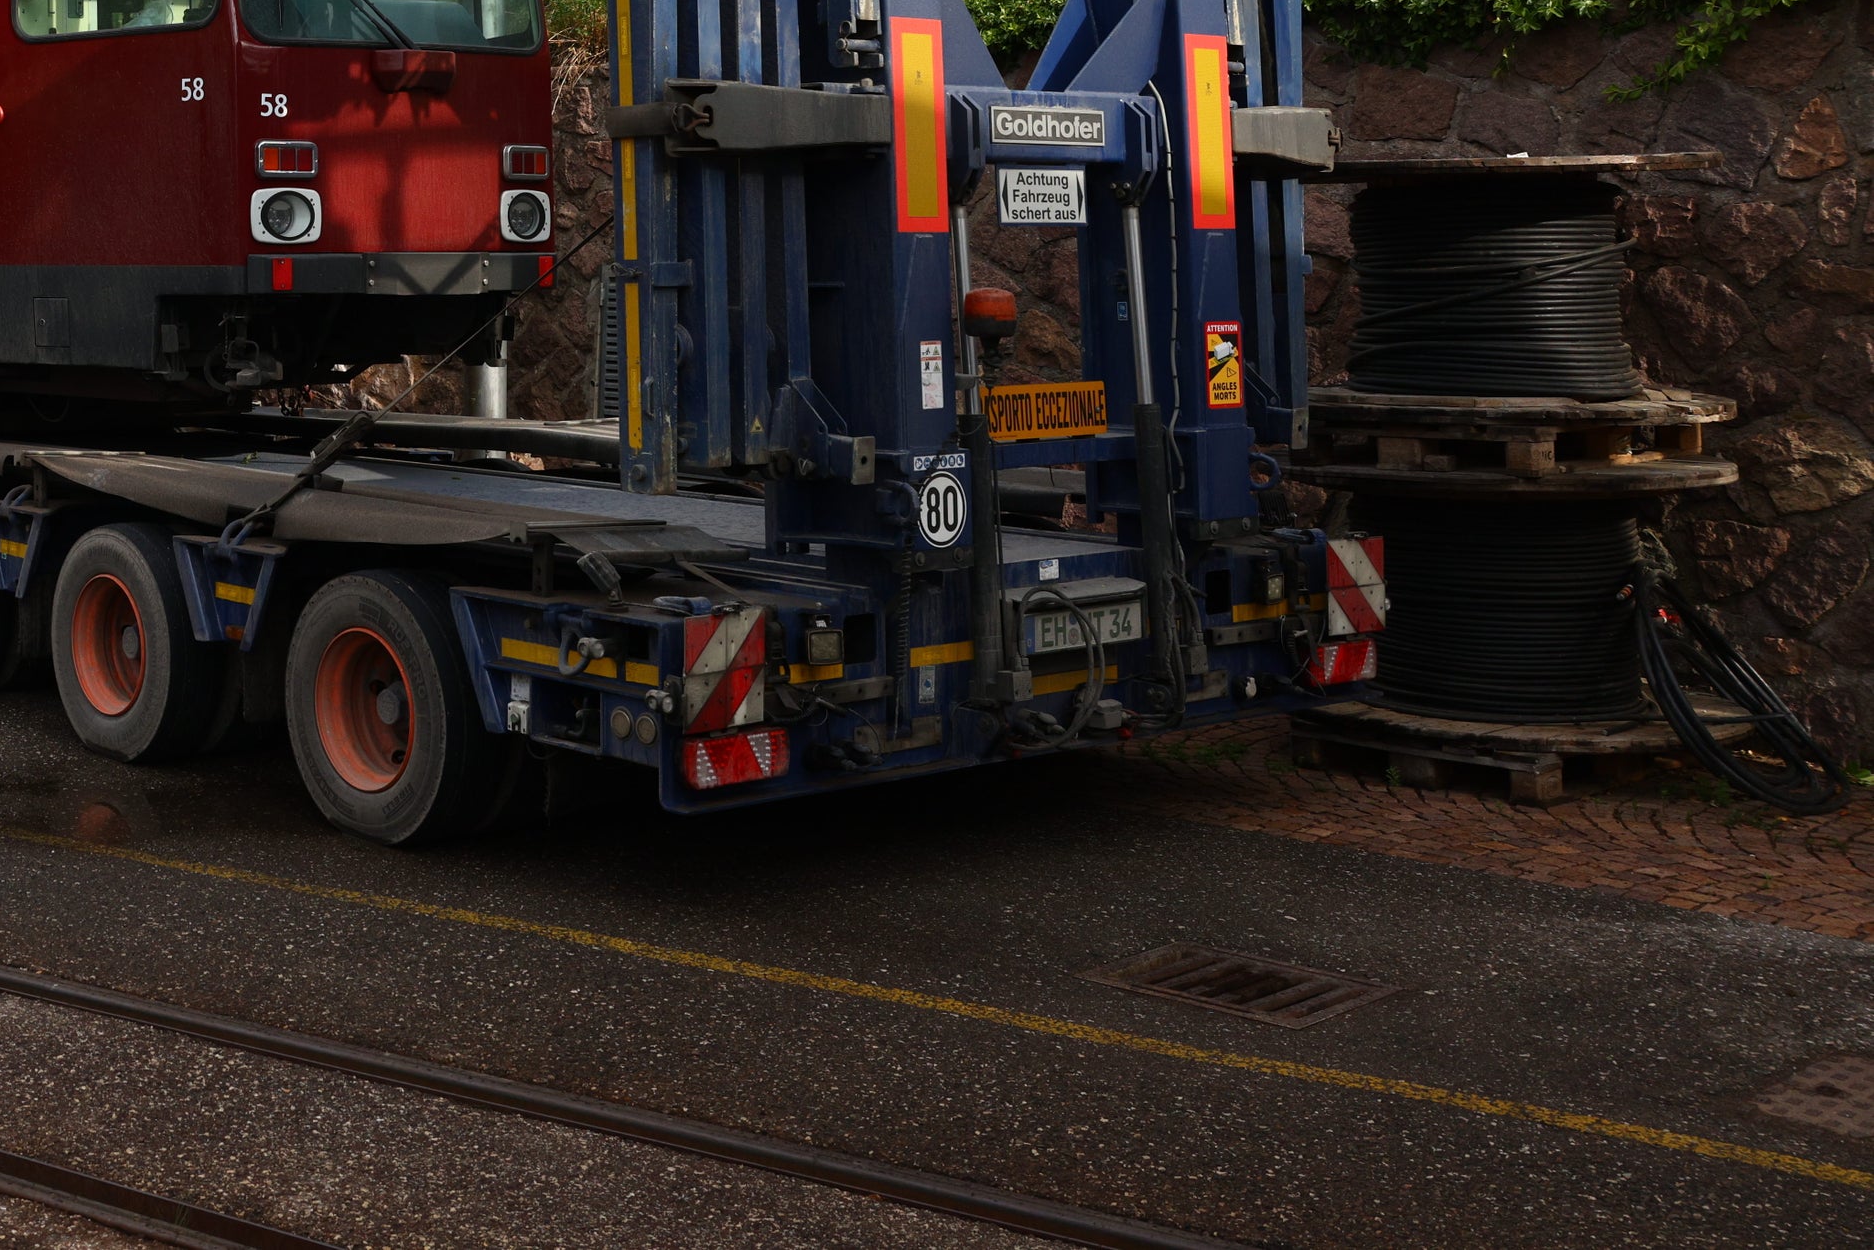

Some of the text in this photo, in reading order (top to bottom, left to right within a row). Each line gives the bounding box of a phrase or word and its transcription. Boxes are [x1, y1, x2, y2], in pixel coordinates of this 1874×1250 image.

[181, 77, 205, 102] 58
[260, 93, 288, 118] 58
[996, 112, 1101, 139] Goldhofer
[1016, 172, 1069, 189] Achtung
[1012, 189, 1071, 207] Fahrzeug
[1011, 207, 1077, 220] schert aus
[1212, 382, 1237, 391] ANGLES
[1214, 392, 1237, 400] MORTS
[981, 390, 1106, 433] SPORTO ECCEZIONALE
[927, 485, 958, 534] 80
[1041, 607, 1132, 648] EH T 34
